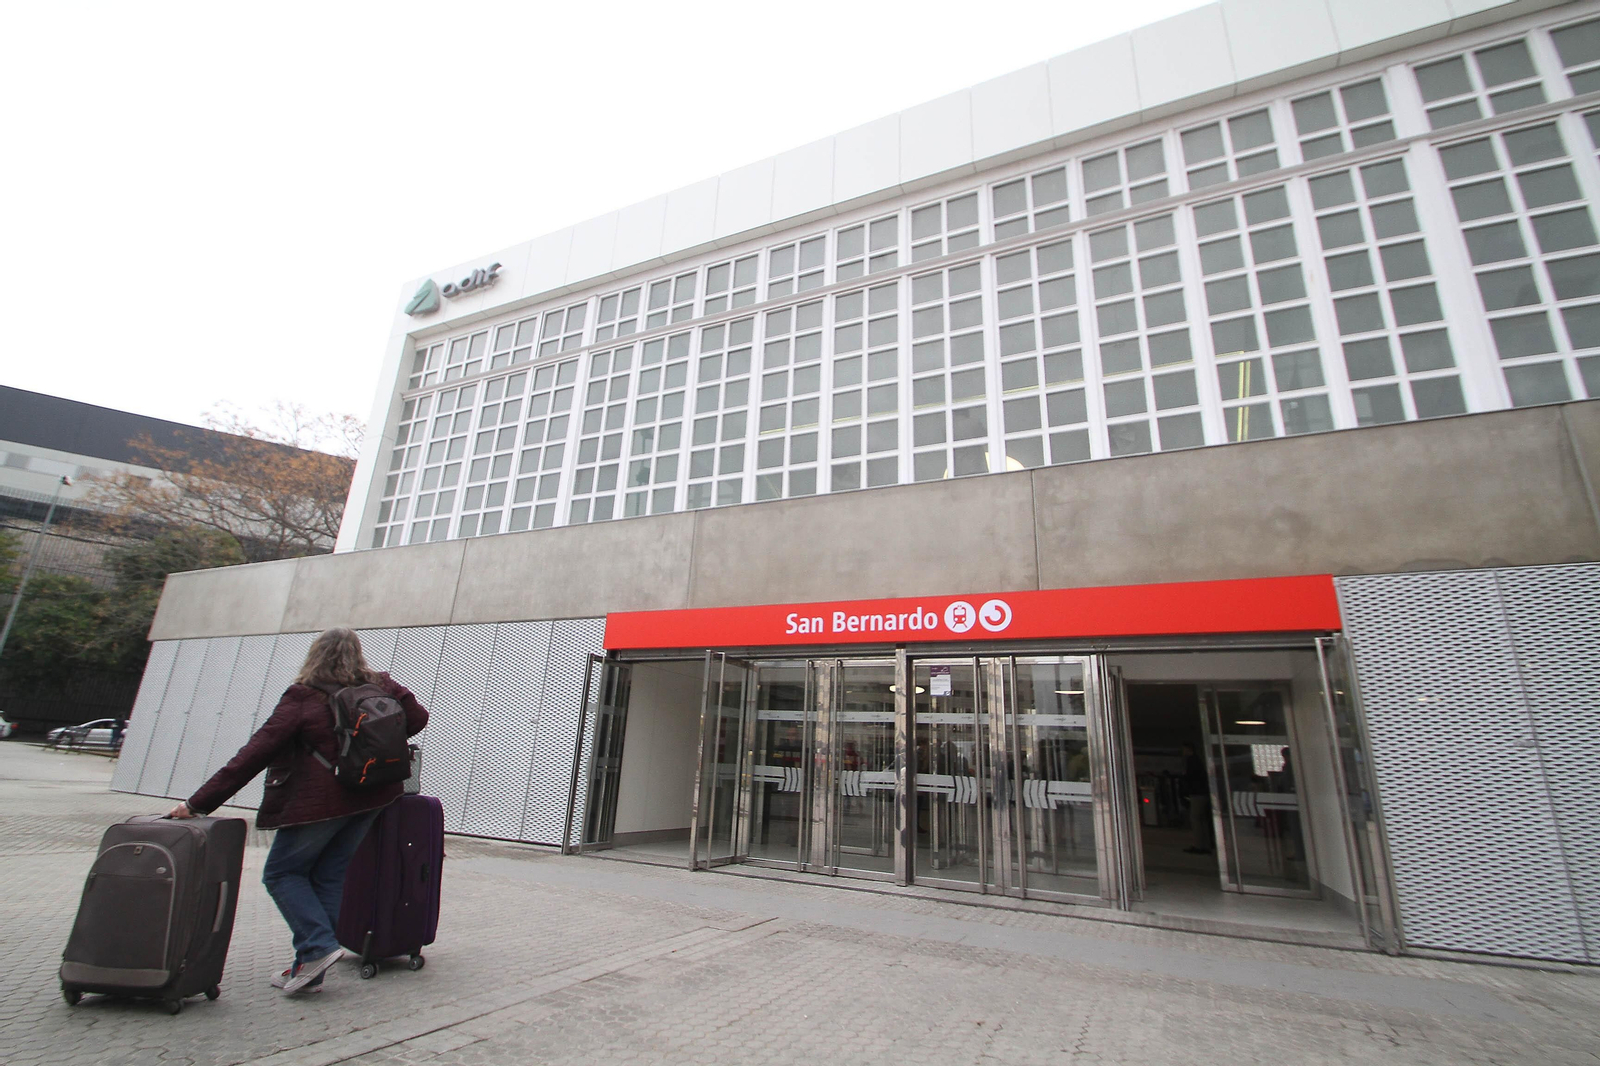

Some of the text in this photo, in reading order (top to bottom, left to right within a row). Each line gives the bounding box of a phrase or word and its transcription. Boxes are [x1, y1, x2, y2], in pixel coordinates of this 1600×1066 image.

[441, 262, 502, 298] adif
[785, 606, 938, 634] San Bernardo
